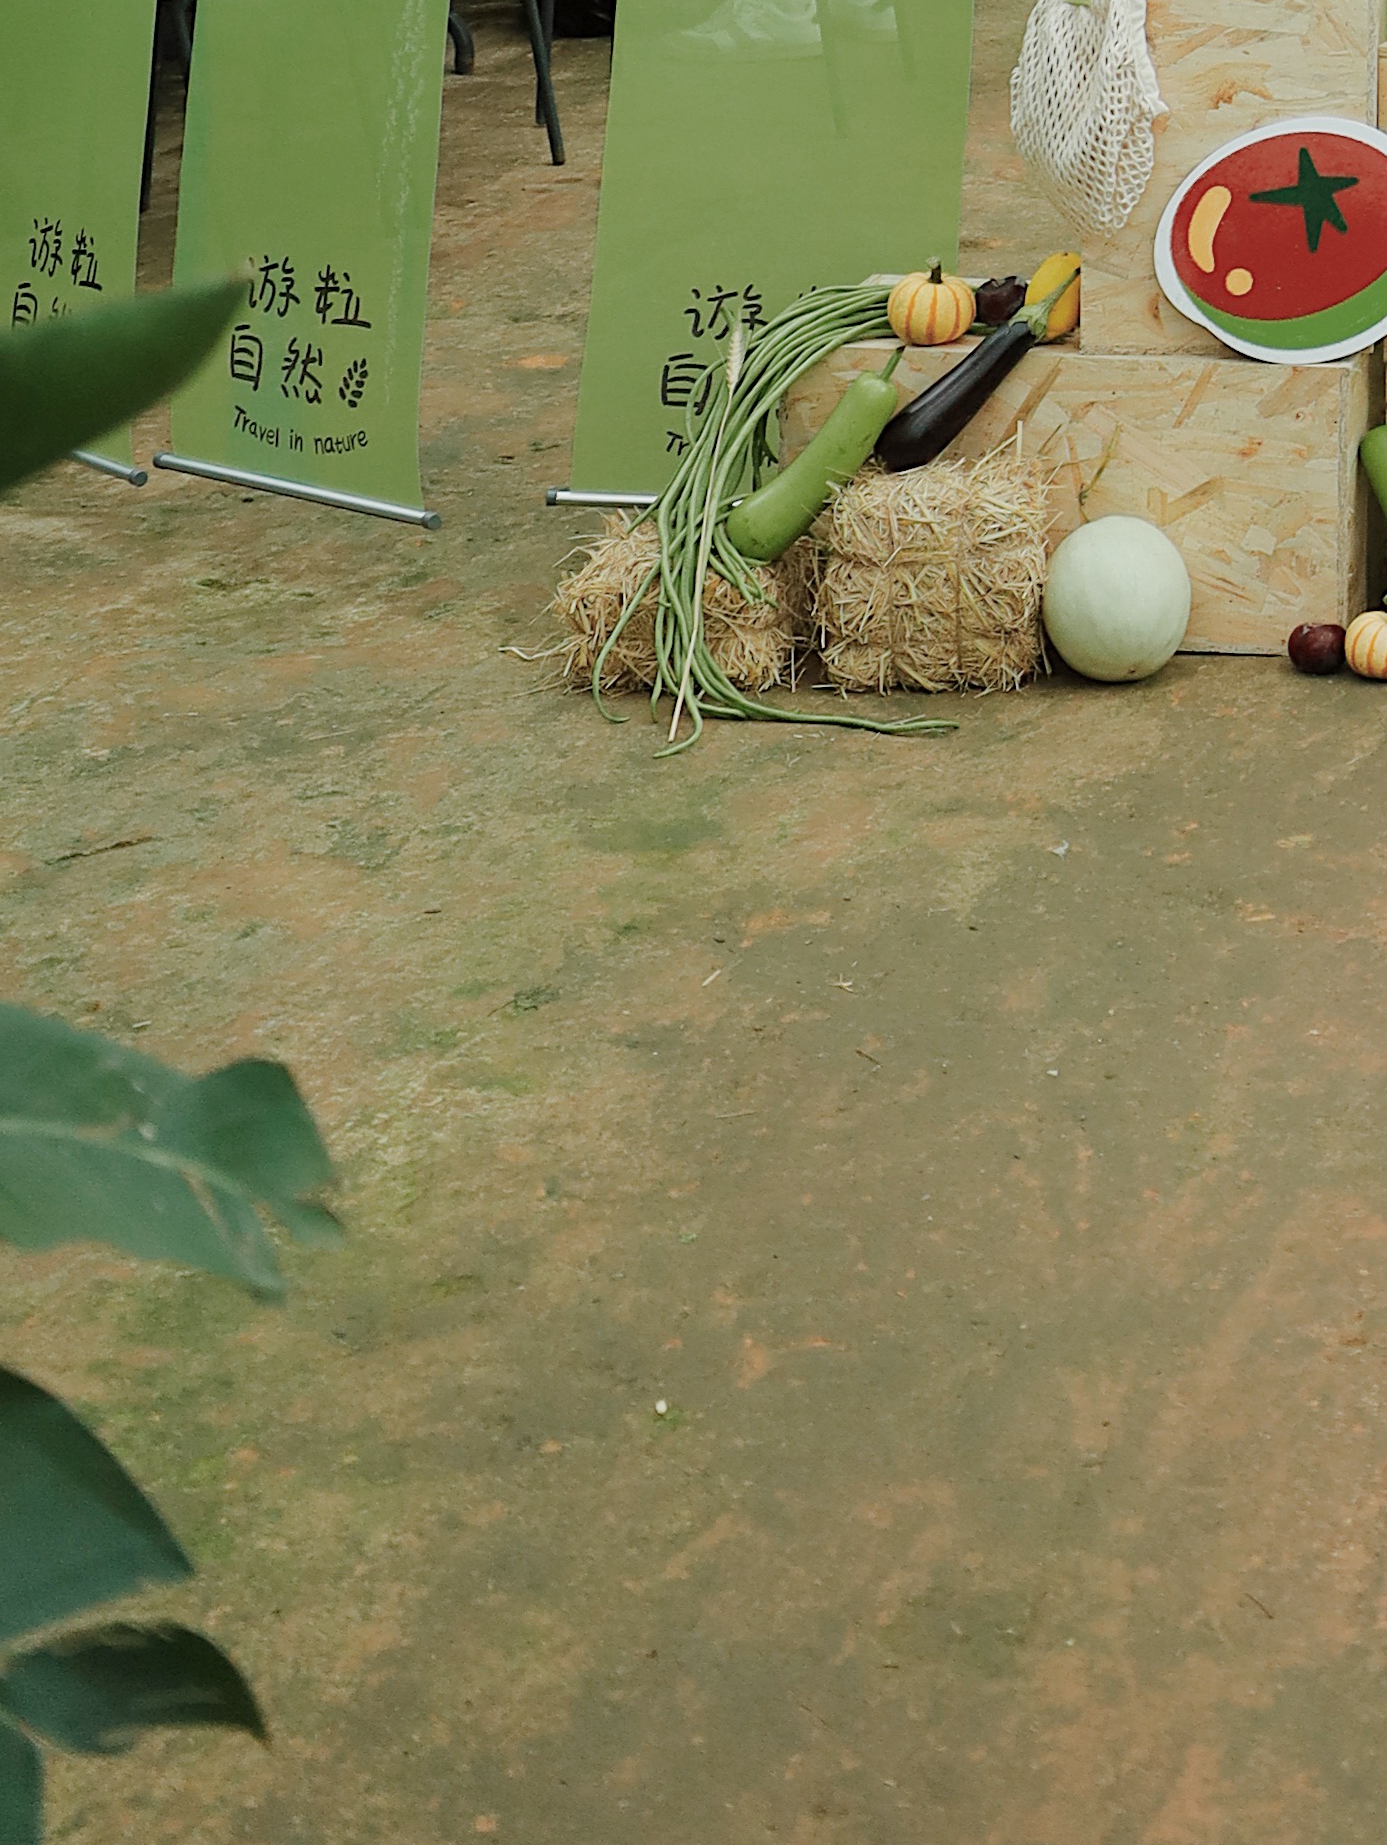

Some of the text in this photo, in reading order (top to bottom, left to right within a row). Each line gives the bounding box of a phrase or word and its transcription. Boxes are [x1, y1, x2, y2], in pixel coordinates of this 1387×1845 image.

[28, 217, 103, 291] 游粒
[247, 254, 372, 329] 游粒
[229, 324, 325, 405] 自然
[233, 404, 369, 455] Travel in nature
